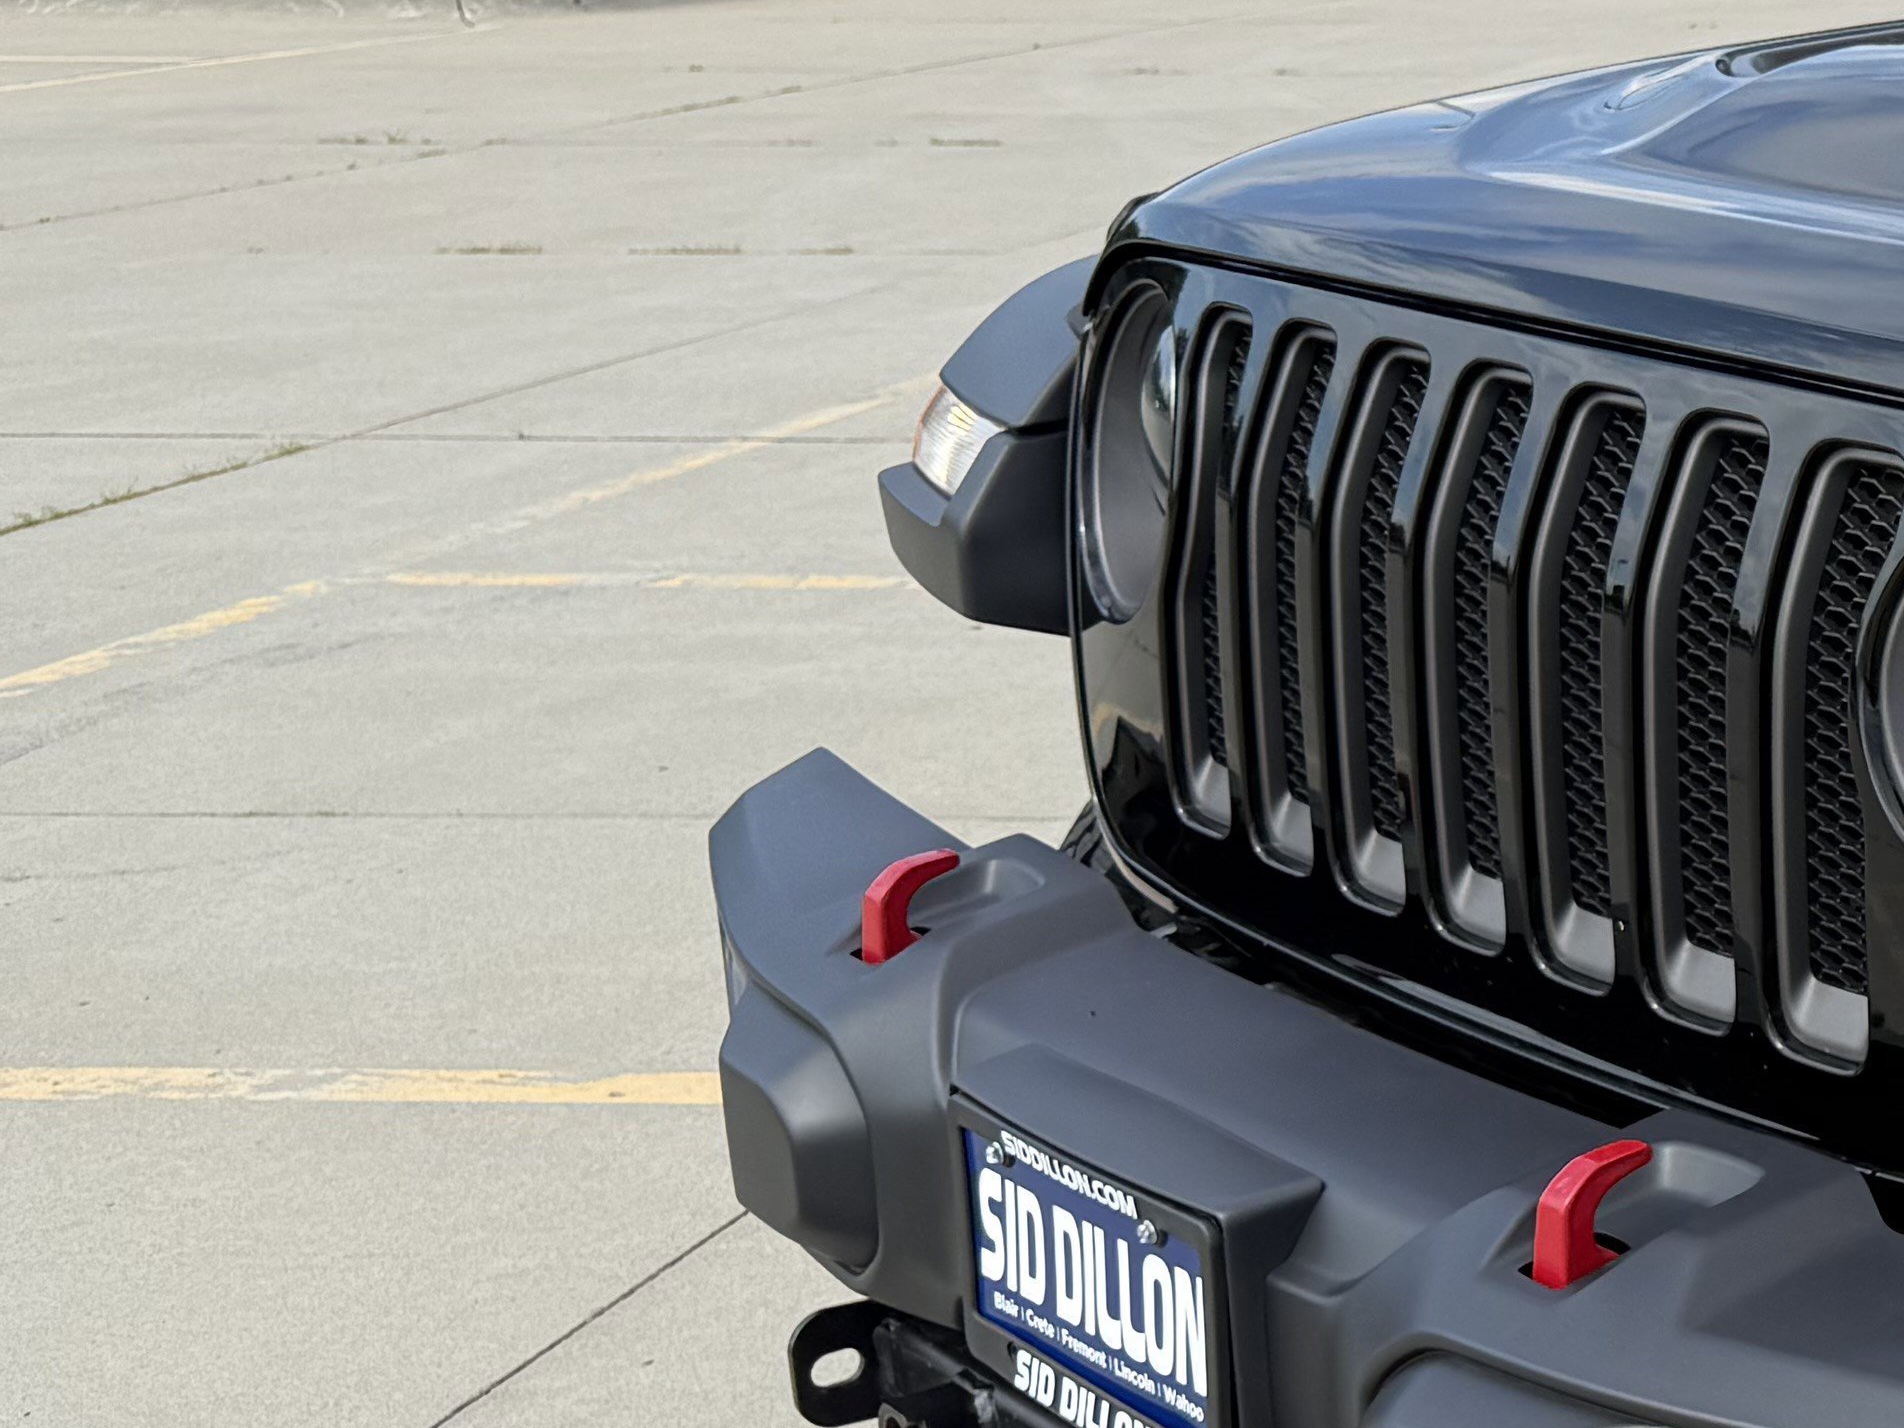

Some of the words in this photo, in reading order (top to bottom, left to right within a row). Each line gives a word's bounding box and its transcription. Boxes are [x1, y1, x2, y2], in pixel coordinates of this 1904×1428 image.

[1000, 1129, 1139, 1220] SIDDILLON.COM
[978, 1166, 1047, 1307] SID
[1052, 1204, 1208, 1397] DILLON
[993, 1291, 1020, 1318] Blair
[1025, 1302, 1056, 1341] Crete
[1061, 1328, 1108, 1369] Fremont
[1114, 1355, 1156, 1396] Lincoln
[1163, 1383, 1205, 1423] Wahoo
[1012, 1347, 1056, 1408] SID
